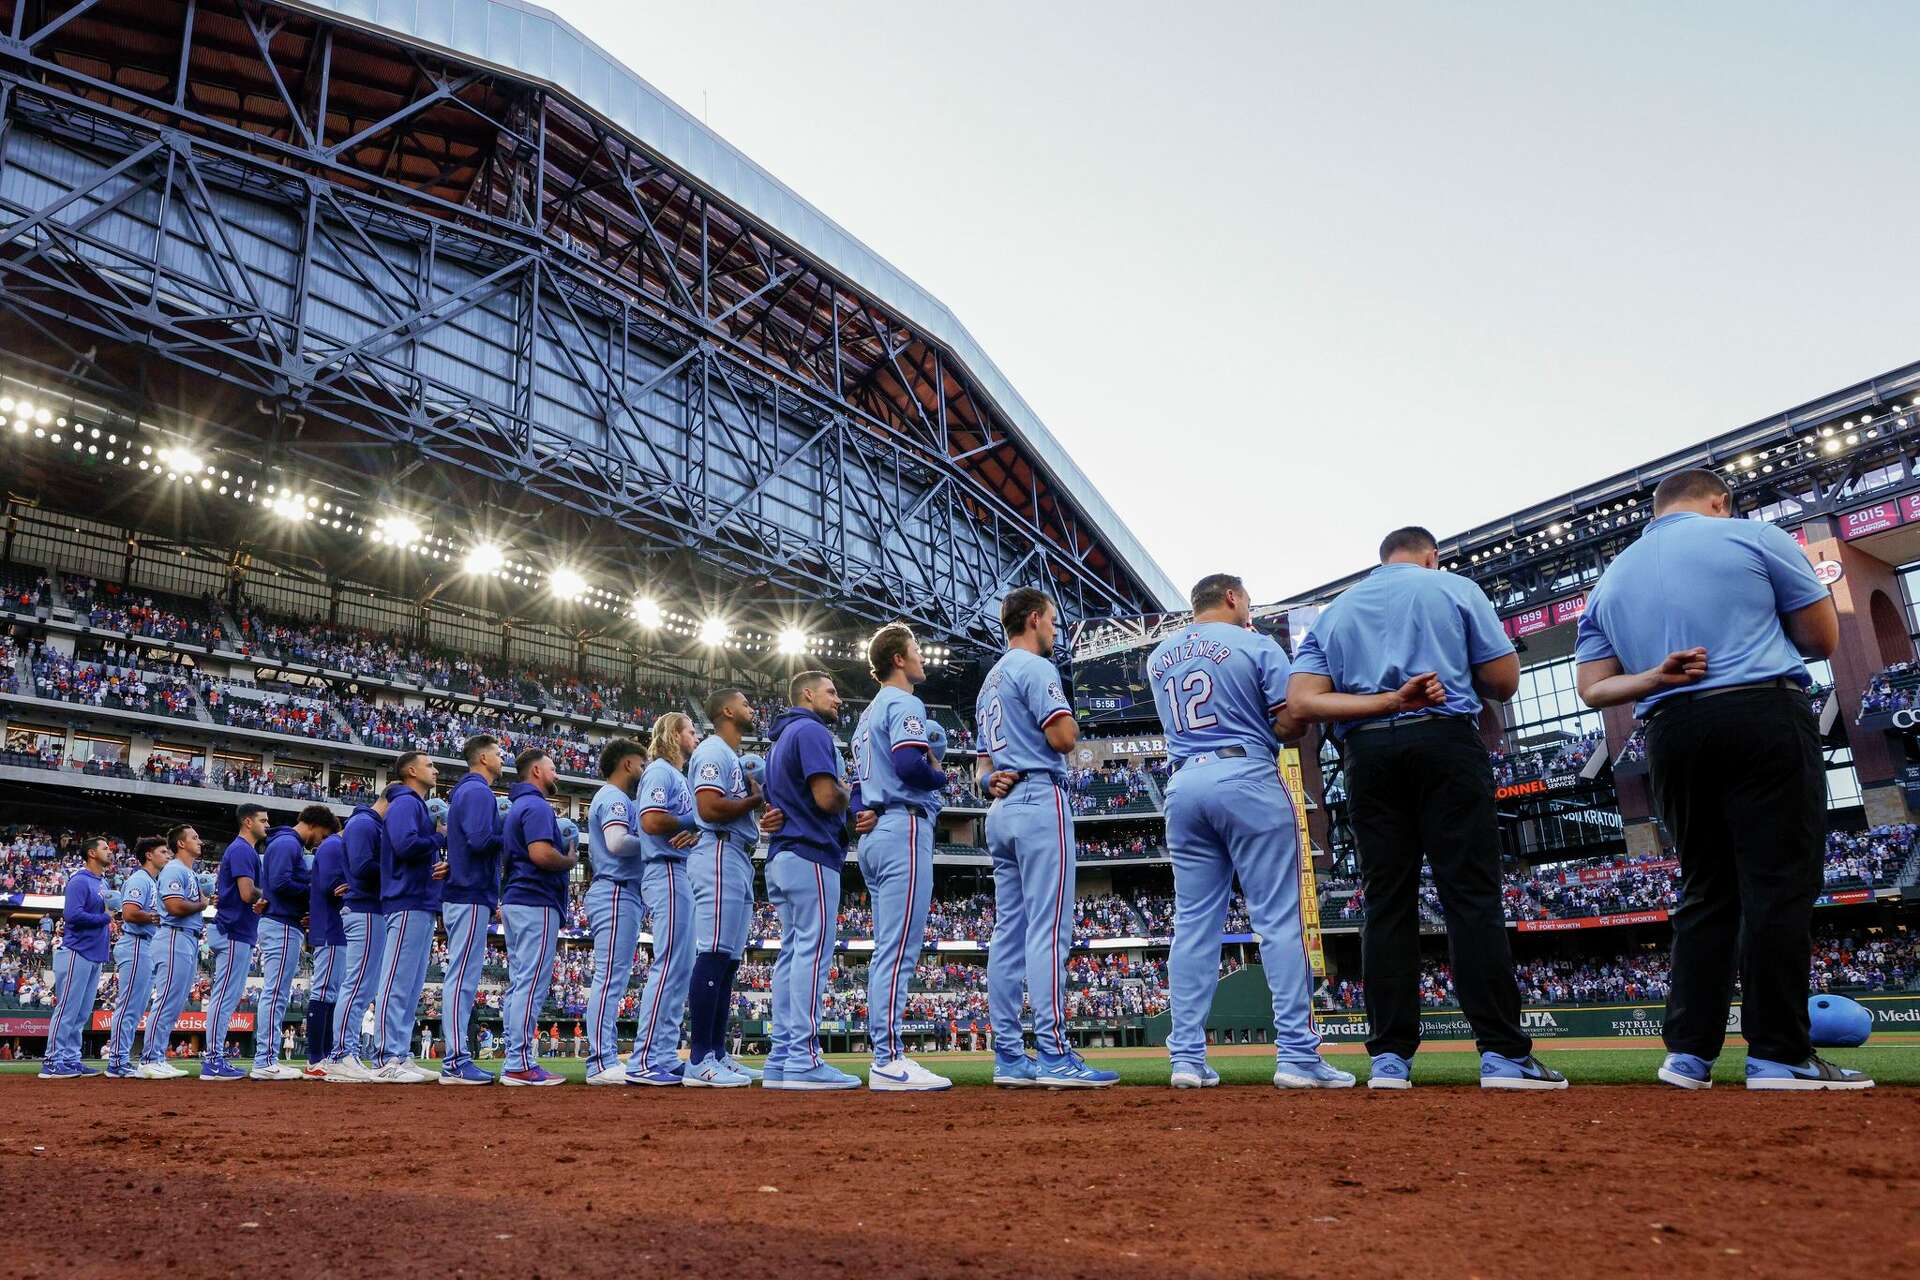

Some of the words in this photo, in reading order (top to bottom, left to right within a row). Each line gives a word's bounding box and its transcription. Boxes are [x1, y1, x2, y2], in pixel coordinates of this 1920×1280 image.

[1849, 506, 1884, 525] 2015
[1559, 598, 1583, 613] 2010
[1518, 610, 1542, 624] 1999
[1151, 640, 1231, 680] KNIZNER
[1163, 669, 1219, 735] 12
[1545, 774, 1576, 785] STAFFING
[1547, 780, 1577, 790] SERVICES
[1494, 780, 1546, 799] ONNEL
[1520, 1012, 1558, 1027] UTA
[1611, 1020, 1663, 1029] ESTRELL
